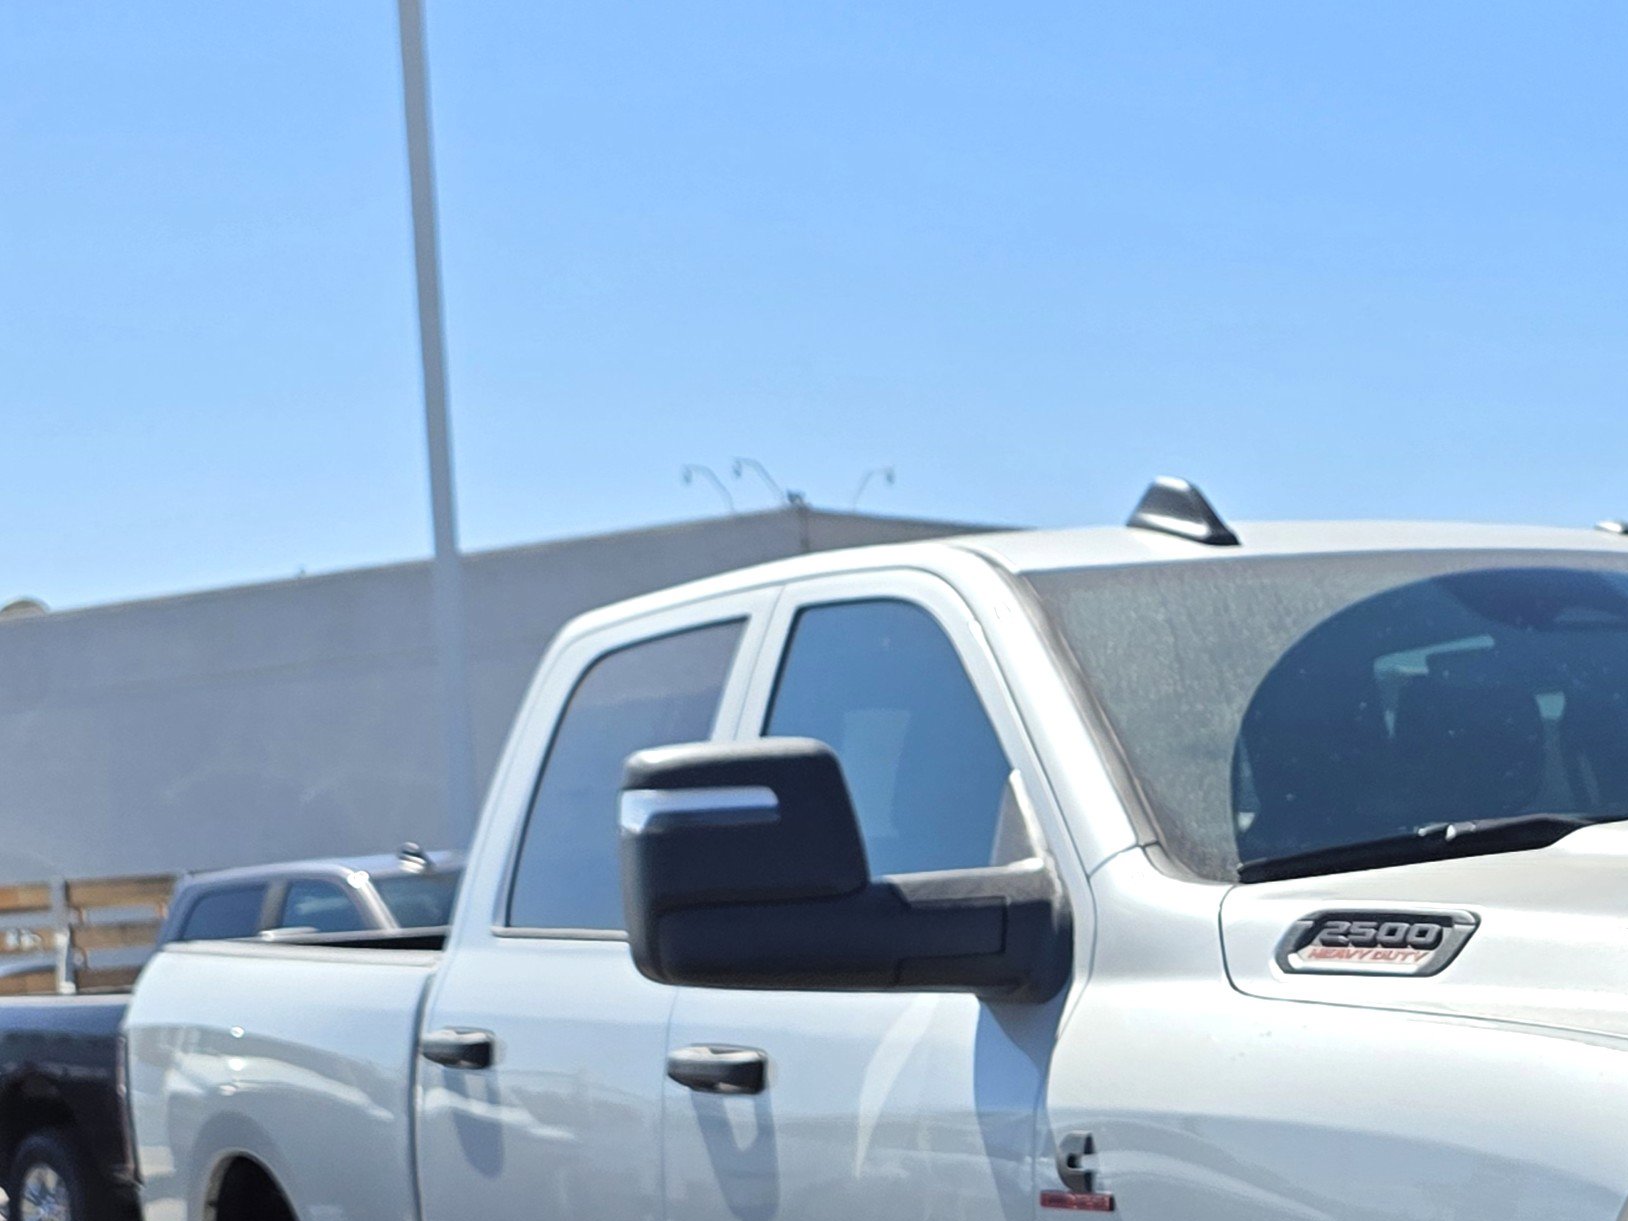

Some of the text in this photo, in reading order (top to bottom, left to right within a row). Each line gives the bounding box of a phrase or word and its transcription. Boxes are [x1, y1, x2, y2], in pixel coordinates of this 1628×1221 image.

[1319, 920, 1444, 950] 2500
[1308, 948, 1429, 963] HEAVY DUTY
